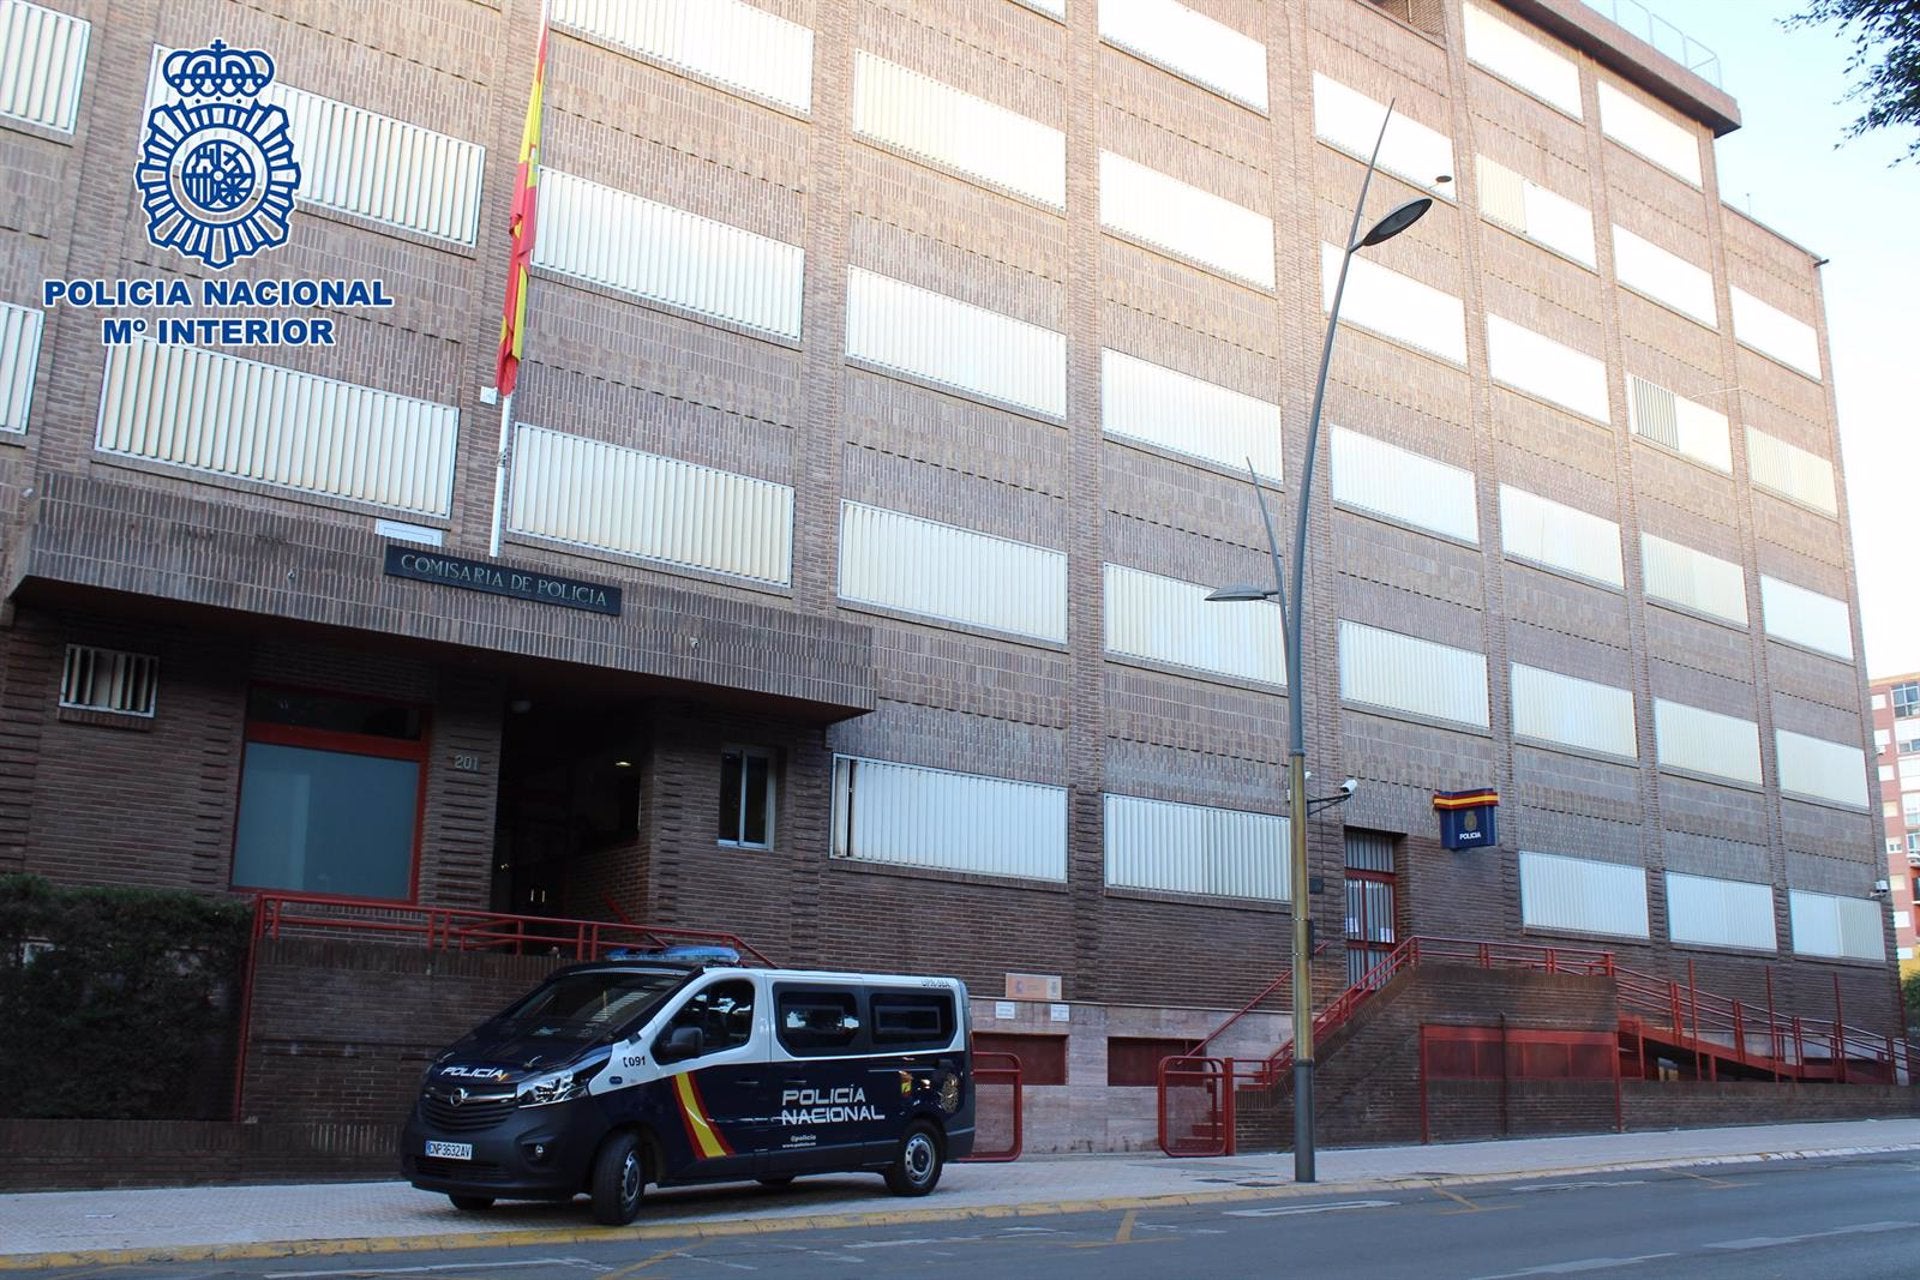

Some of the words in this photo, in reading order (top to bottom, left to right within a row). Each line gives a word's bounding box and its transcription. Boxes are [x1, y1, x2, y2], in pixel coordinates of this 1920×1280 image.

[401, 553, 503, 587] COMISARIA
[510, 575, 532, 593] DE
[537, 579, 607, 606] POLICIA
[454, 754, 479, 771] 201
[628, 1056, 646, 1067] 091
[781, 1105, 886, 1126] NACIONAL
